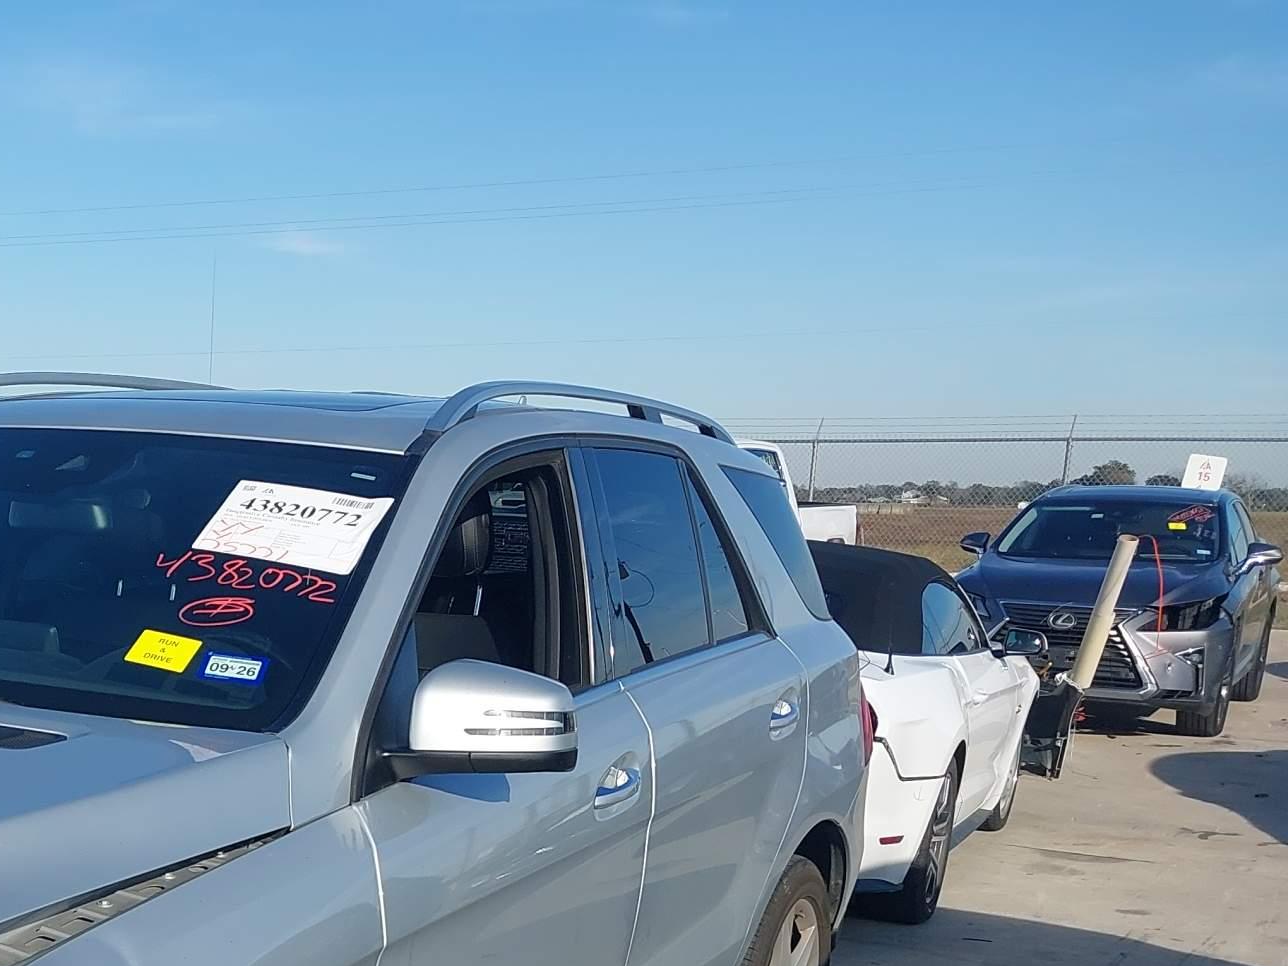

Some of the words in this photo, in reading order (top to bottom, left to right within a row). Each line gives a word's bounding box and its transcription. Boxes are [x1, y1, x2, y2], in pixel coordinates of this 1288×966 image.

[239, 497, 362, 527] 43820772
[156, 551, 337, 603] 43820772
[158, 638, 181, 647] RUN
[143, 652, 173, 664] DRIVE
[209, 662, 229, 673] 09
[235, 665, 257, 676] 26
